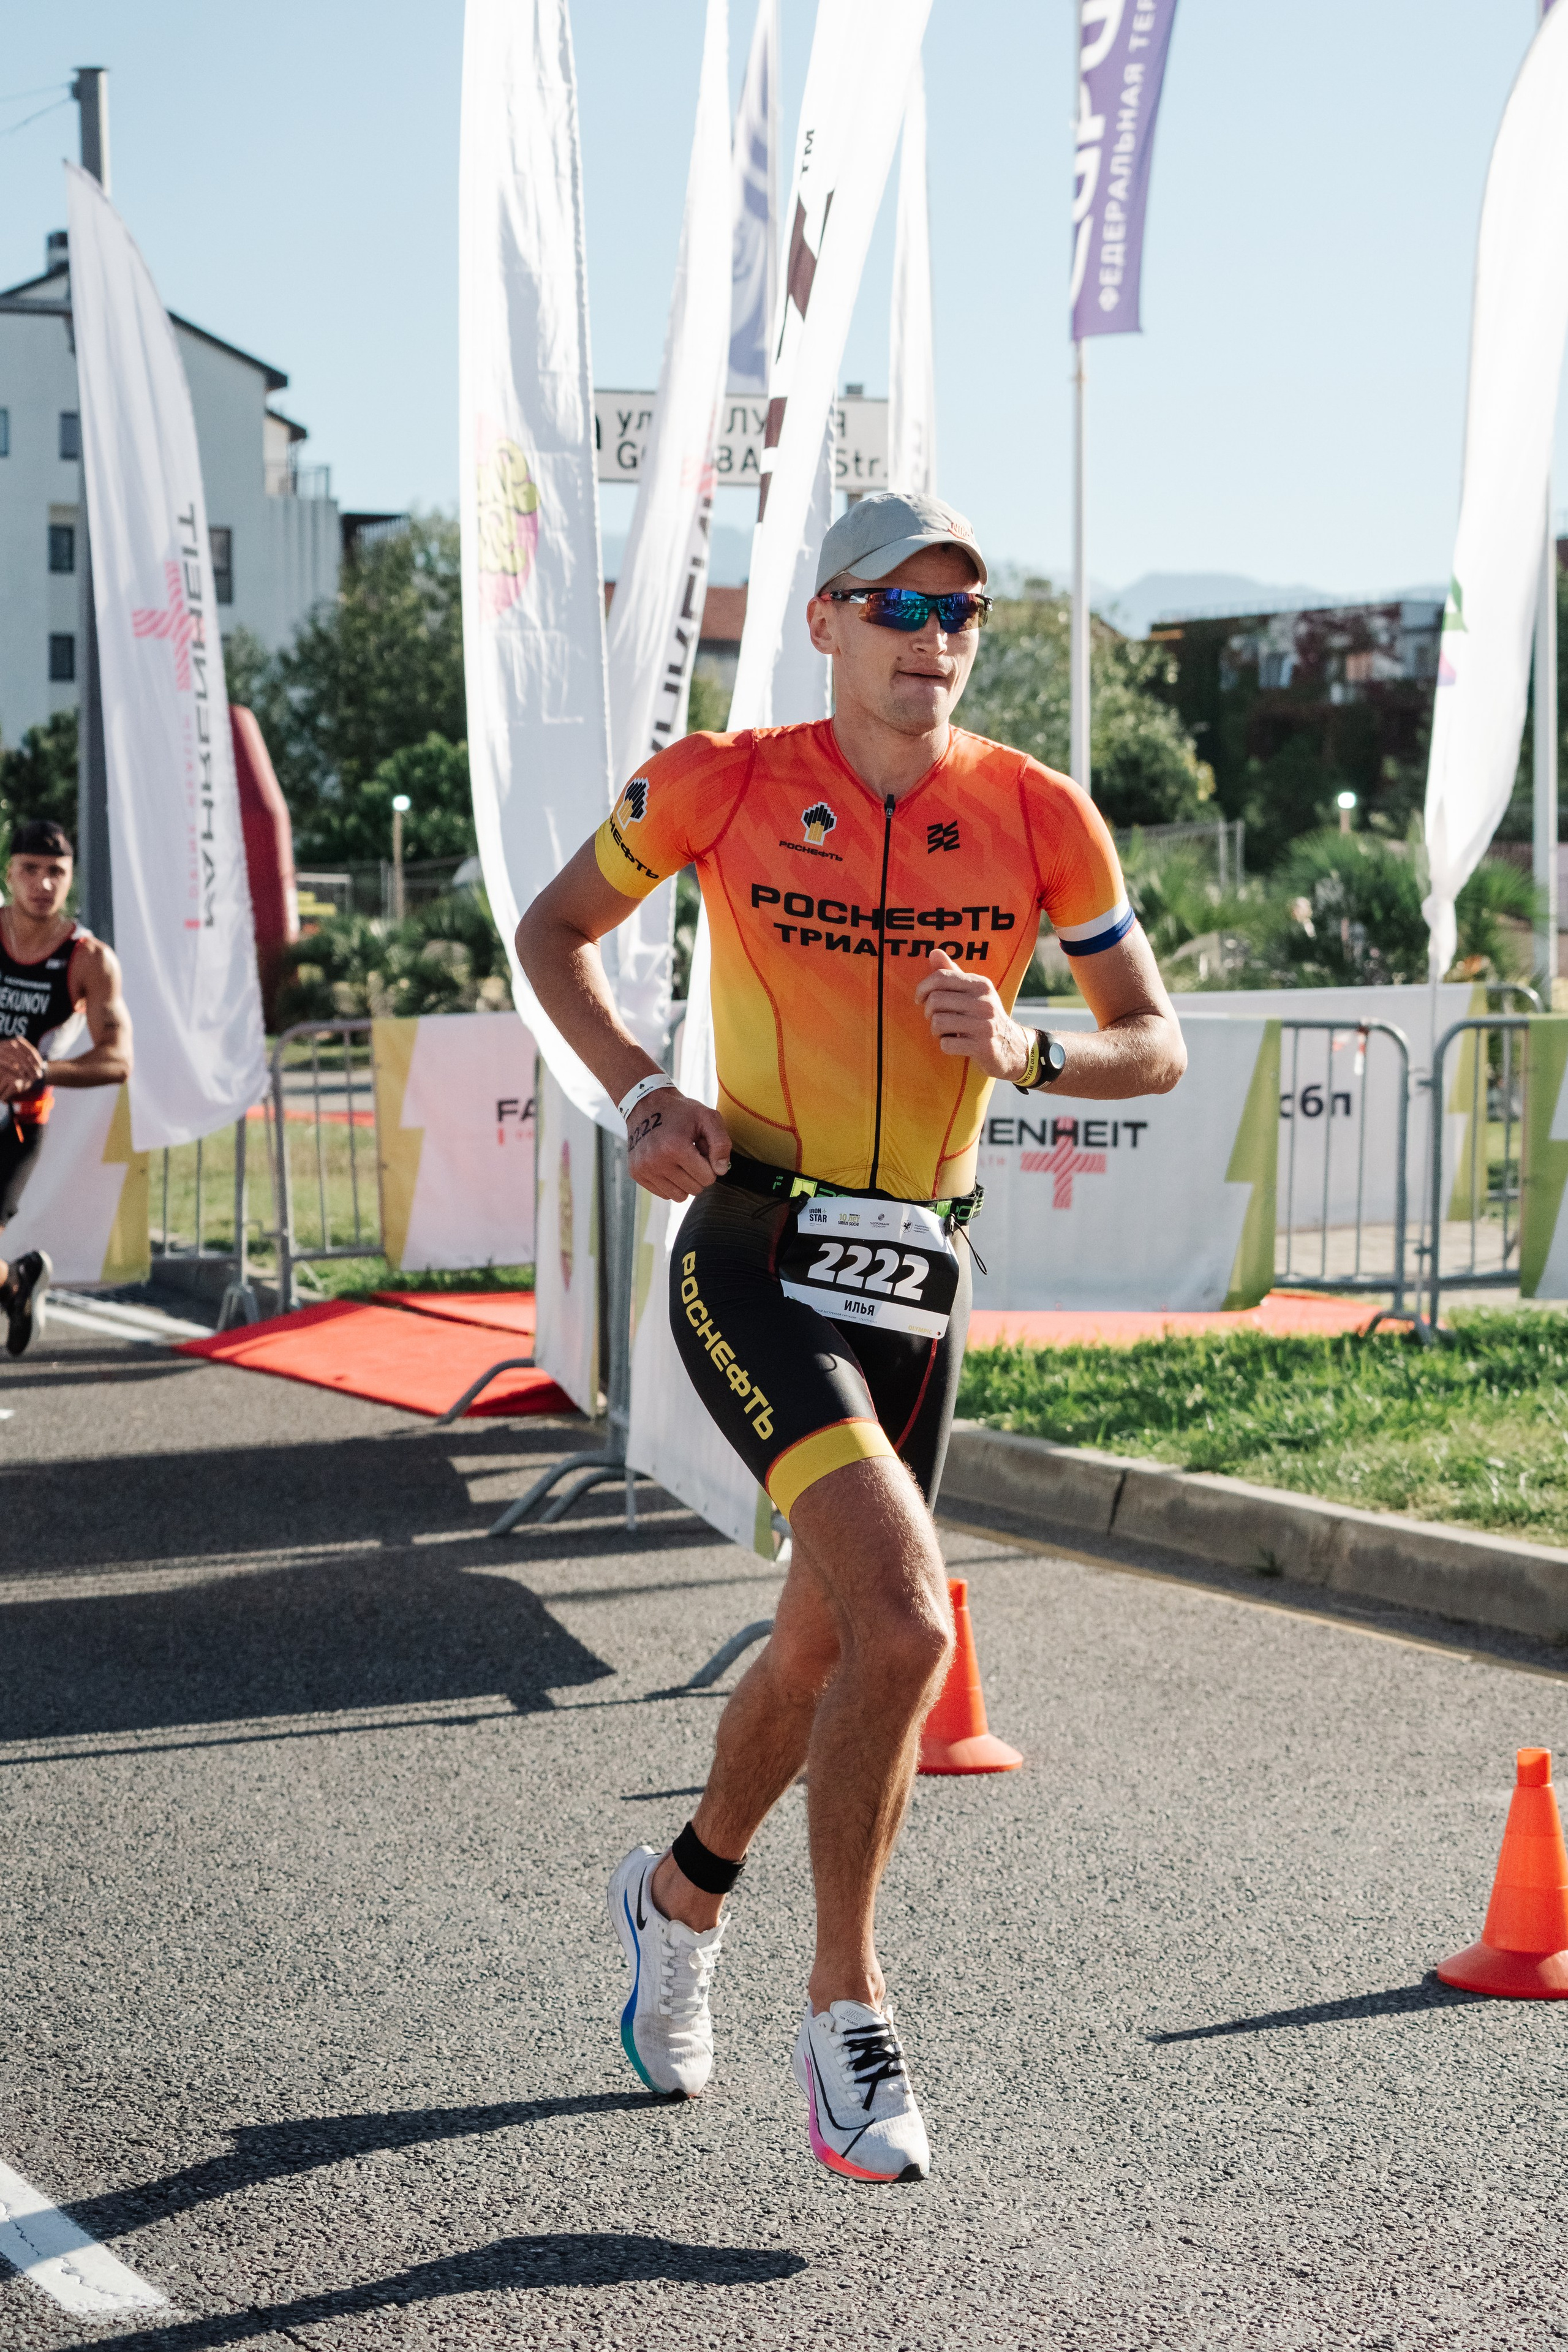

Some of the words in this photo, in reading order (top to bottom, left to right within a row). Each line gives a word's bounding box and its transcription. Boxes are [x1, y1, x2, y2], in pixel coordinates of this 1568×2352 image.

[1098, 62, 1146, 312] ФЕДЕРАЛЬНАЯ
[779, 840, 843, 862] РОСНЕФТЬ
[751, 883, 1016, 931] РОСНЕФТЬ
[773, 923, 989, 961] ТРИАТЛОН
[0, 986, 50, 1015] EKUNOV
[628, 1112, 663, 1152] 2222
[981, 1117, 1148, 1148] ENHEIT
[809, 1214, 827, 1223] STAR
[807, 1242, 930, 1301] 2222
[843, 1299, 876, 1316] ИЛЬЯ
[908, 1325, 933, 1334] OLYMPIC
[681, 1251, 775, 1441] РОСНЕФТЬ
[844, 2008, 865, 2021] NIKE
